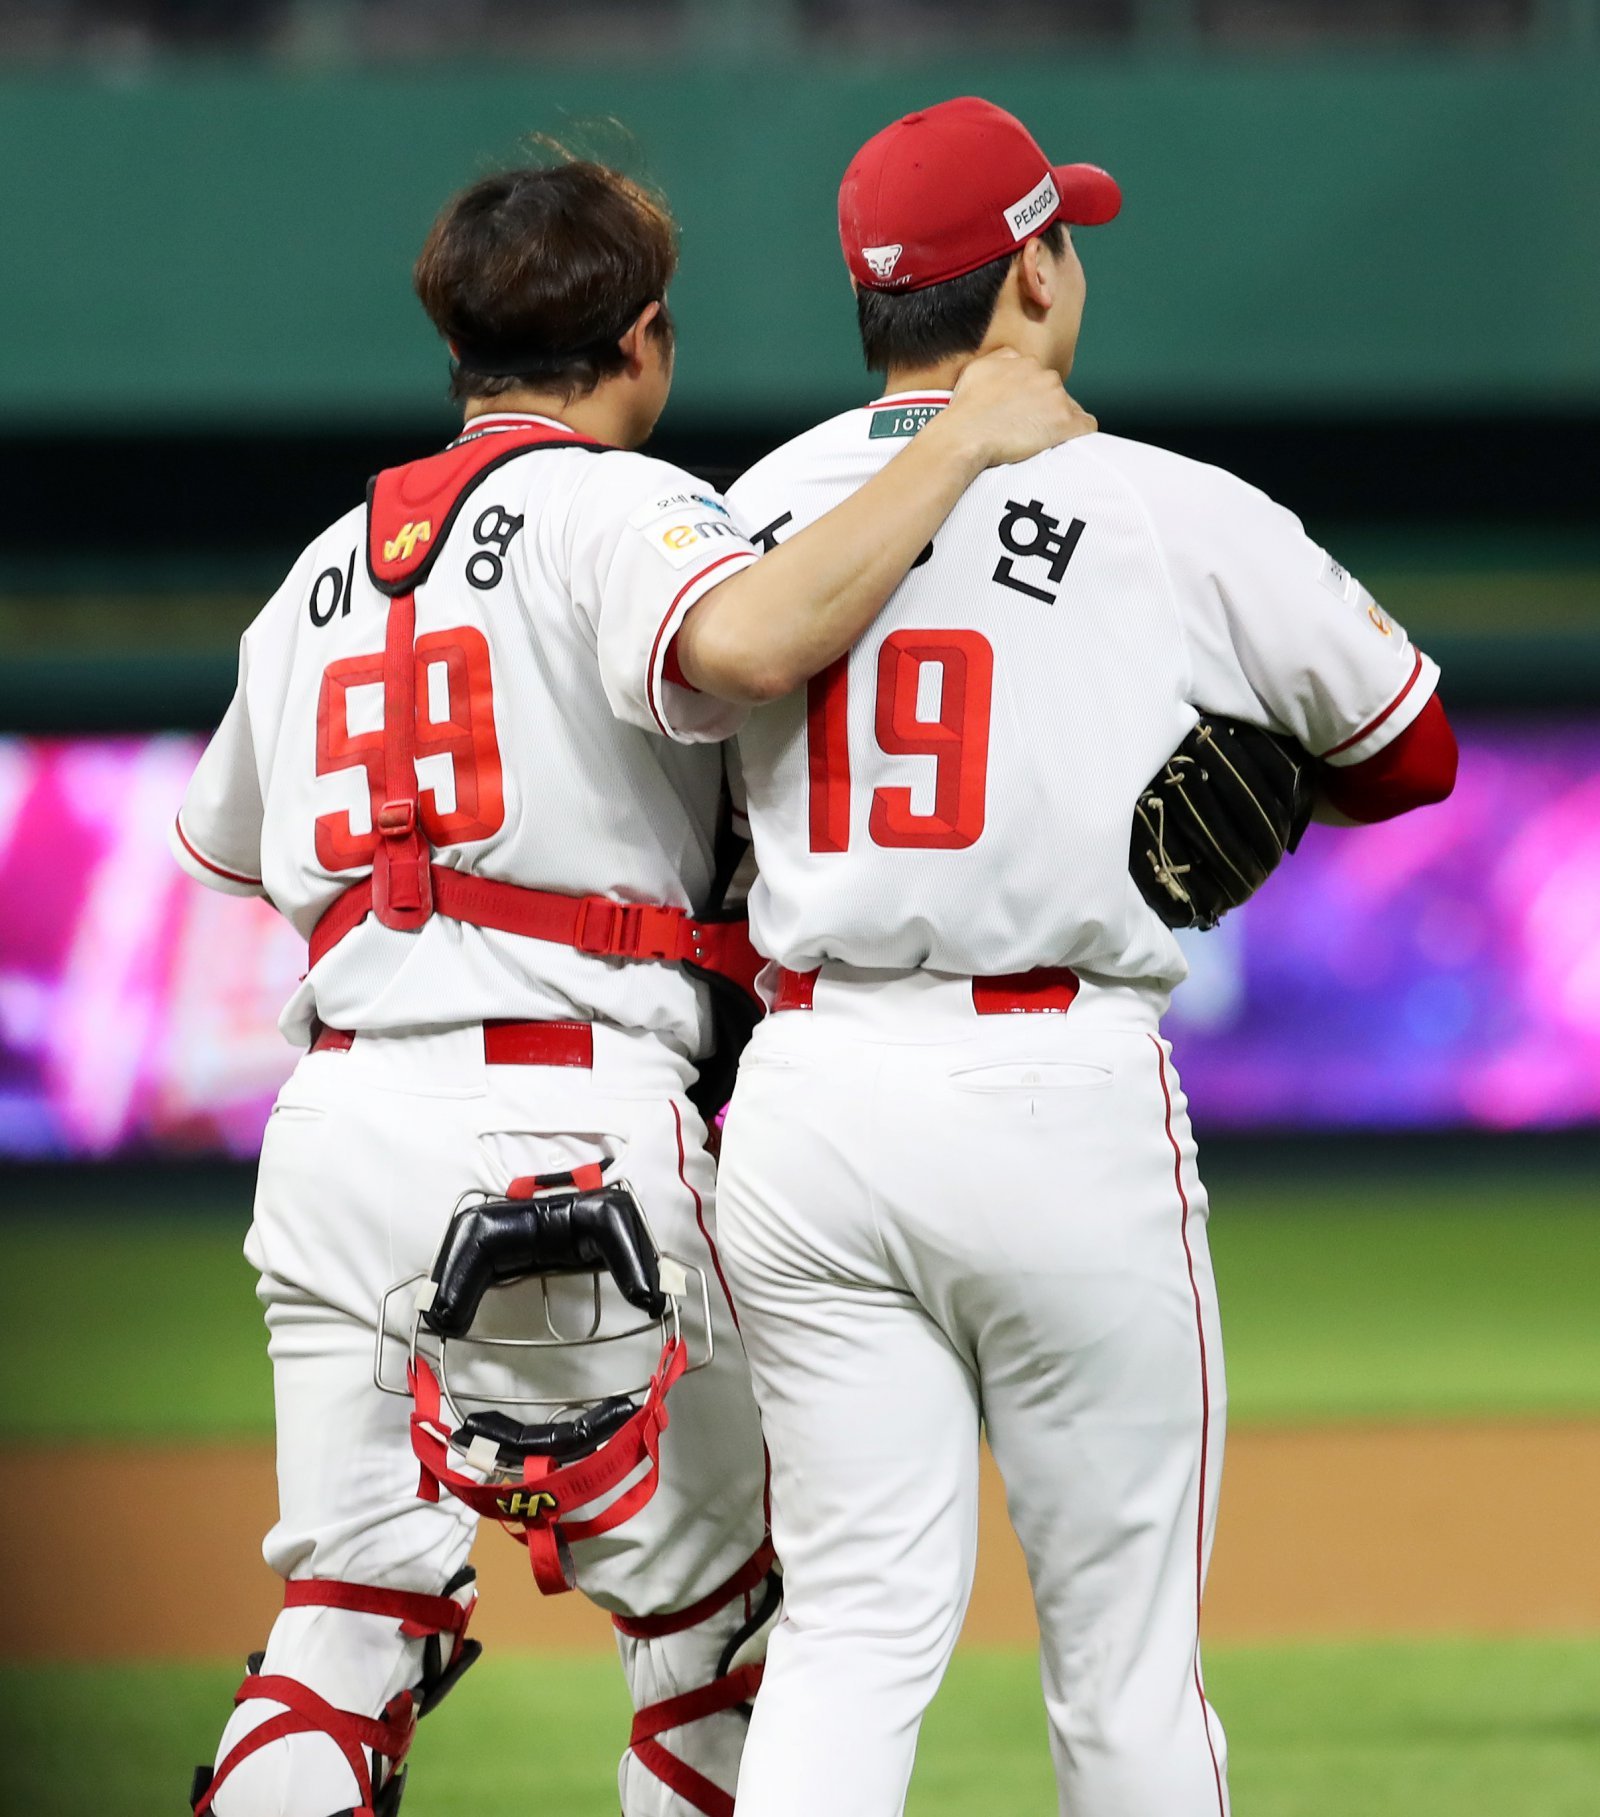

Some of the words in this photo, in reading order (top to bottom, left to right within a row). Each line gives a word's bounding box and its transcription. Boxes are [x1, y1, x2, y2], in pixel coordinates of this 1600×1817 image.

[1013, 185, 1055, 229] PEACOCK
[892, 417, 926, 434] JOS
[906, 408, 941, 416] GRAN
[314, 625, 505, 872] 59
[807, 628, 994, 853] 19
